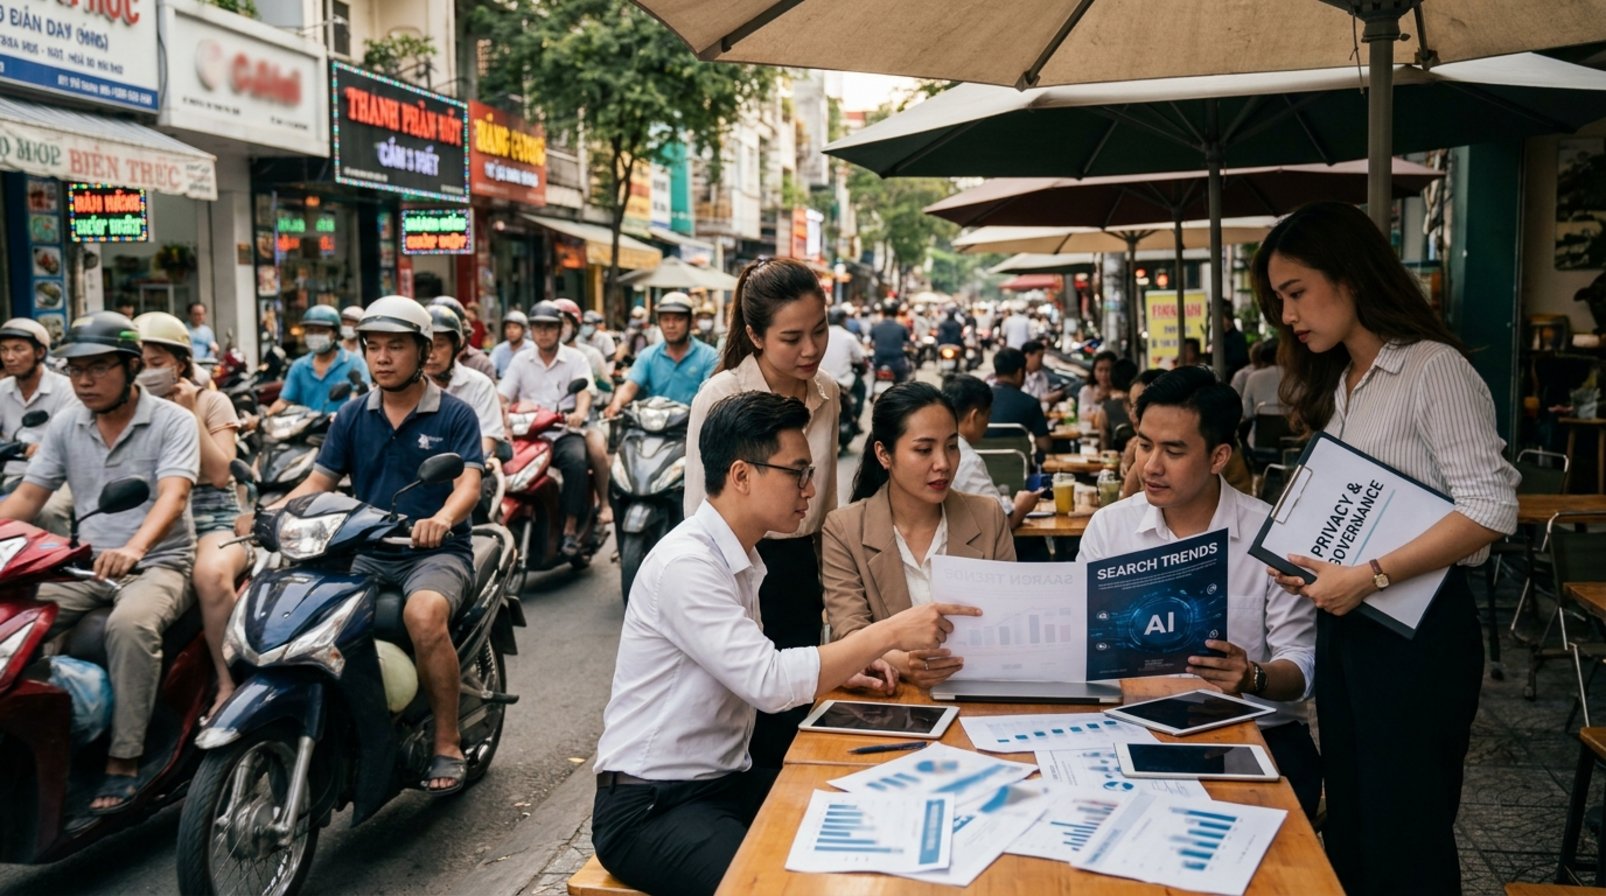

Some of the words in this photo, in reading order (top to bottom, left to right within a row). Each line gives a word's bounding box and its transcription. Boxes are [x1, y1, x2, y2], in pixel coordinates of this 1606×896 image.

[1310, 493, 1353, 558] PRIVACY
[1347, 482, 1363, 494] &
[1097, 558, 1158, 580] SEARCH
[1160, 542, 1218, 568] TRENDS
[1144, 611, 1175, 636] AI
